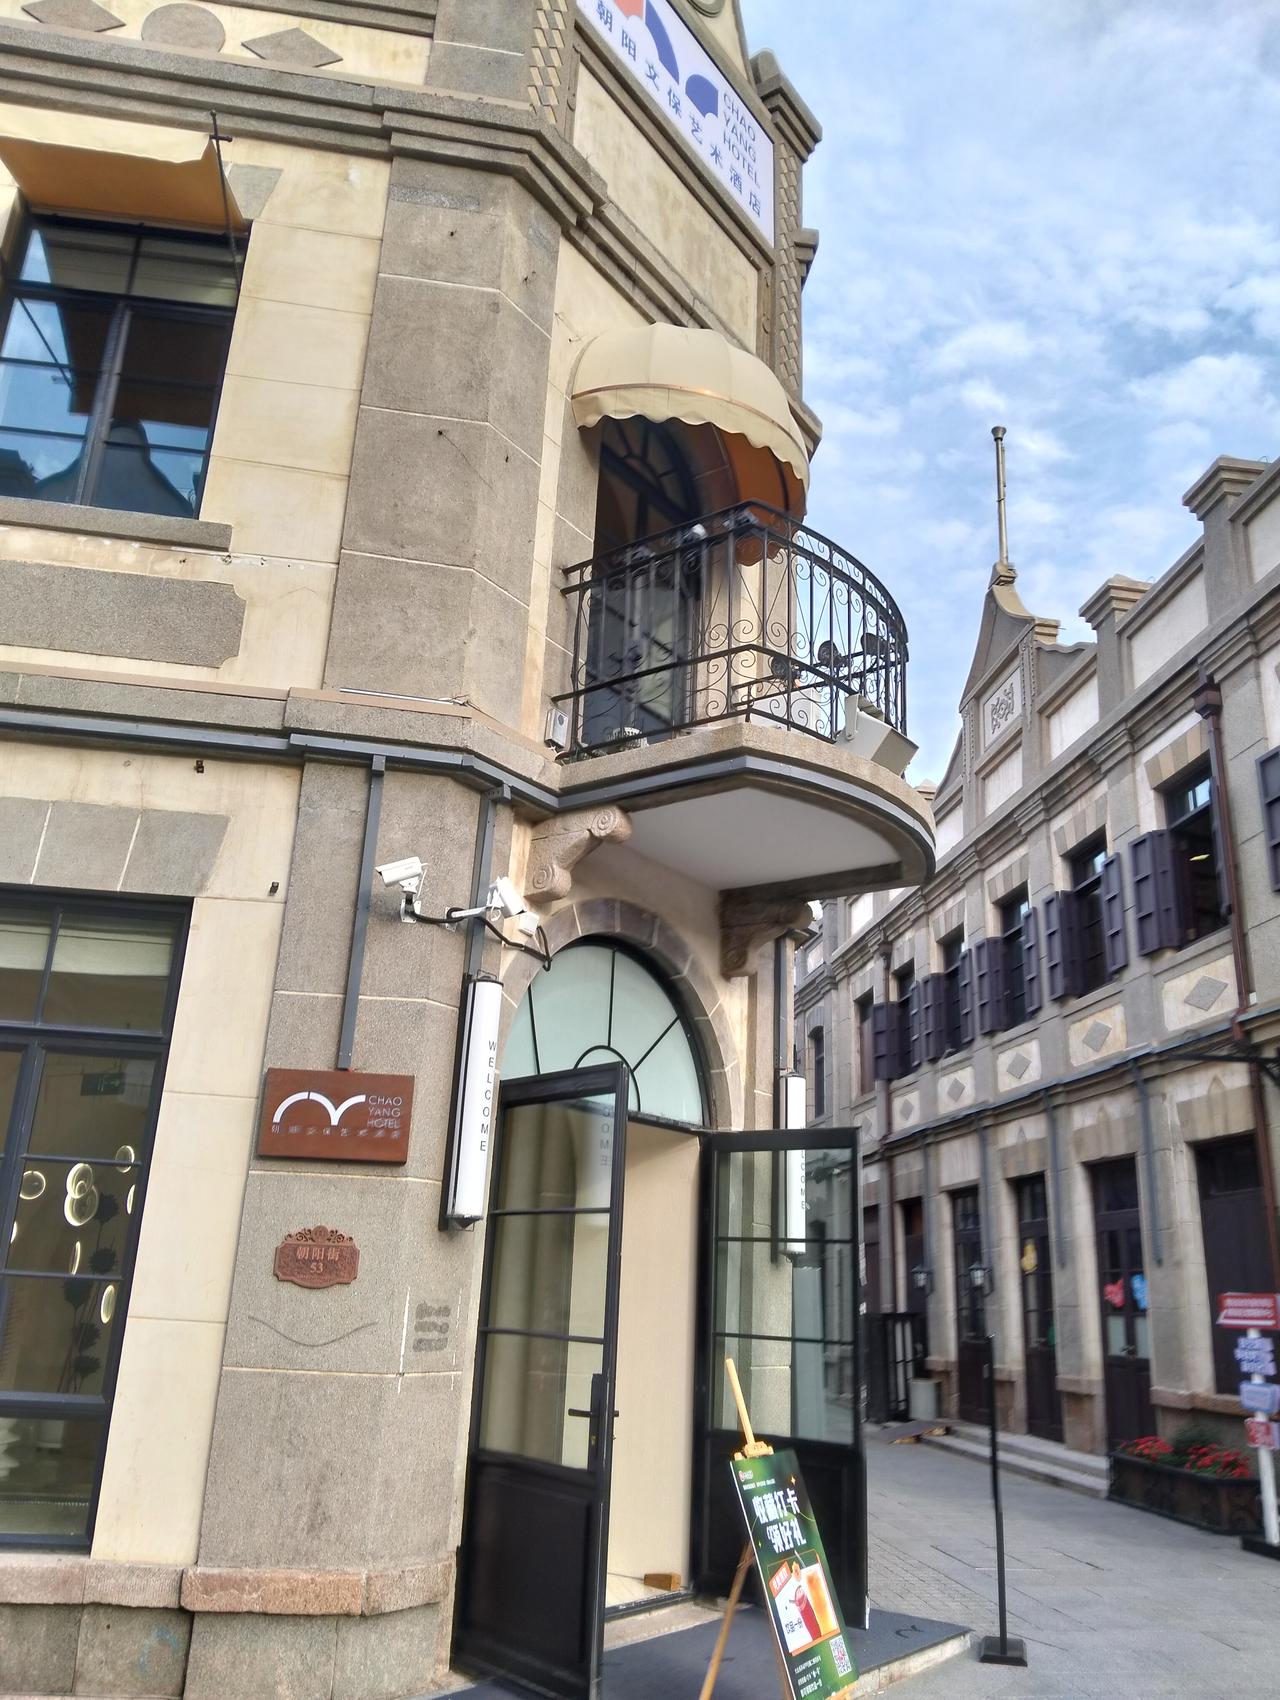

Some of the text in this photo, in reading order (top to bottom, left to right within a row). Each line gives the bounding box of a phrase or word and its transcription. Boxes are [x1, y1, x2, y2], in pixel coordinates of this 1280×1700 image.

[723, 92, 756, 142] CHAO
[723, 111, 757, 163] YANG
[723, 130, 761, 189] HOTEL
[368, 1094, 403, 1106] CHAO
[368, 1106, 401, 1118] YANG
[480, 1039, 497, 1152] WELCOME
[367, 1117, 401, 1129] HOTEL
[310, 1262, 324, 1274] 53
[751, 1487, 800, 1524] 收藏打卡
[766, 1517, 807, 1554] 领好礼
